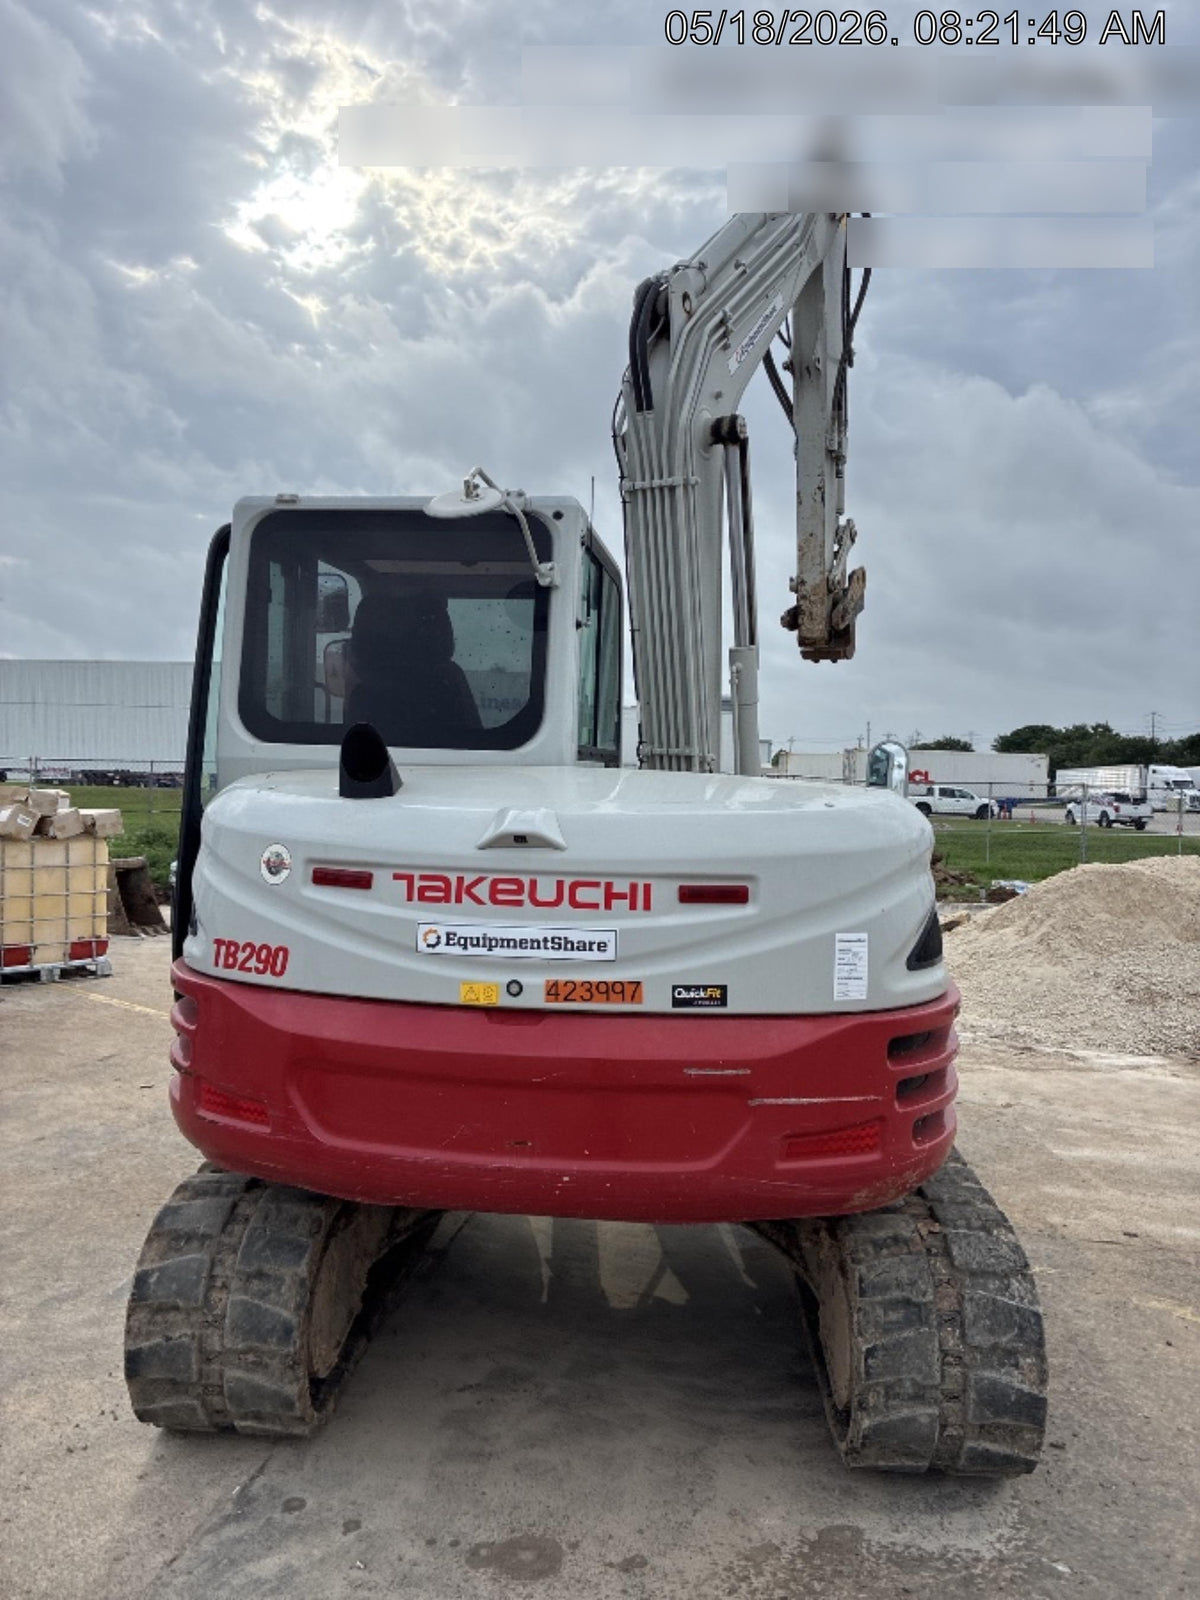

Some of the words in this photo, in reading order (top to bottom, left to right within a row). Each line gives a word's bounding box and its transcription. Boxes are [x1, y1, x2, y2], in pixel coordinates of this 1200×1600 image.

[445, 932, 608, 952] EquipmentShare
[212, 938, 290, 977] TB290
[546, 980, 641, 1002] 423997
